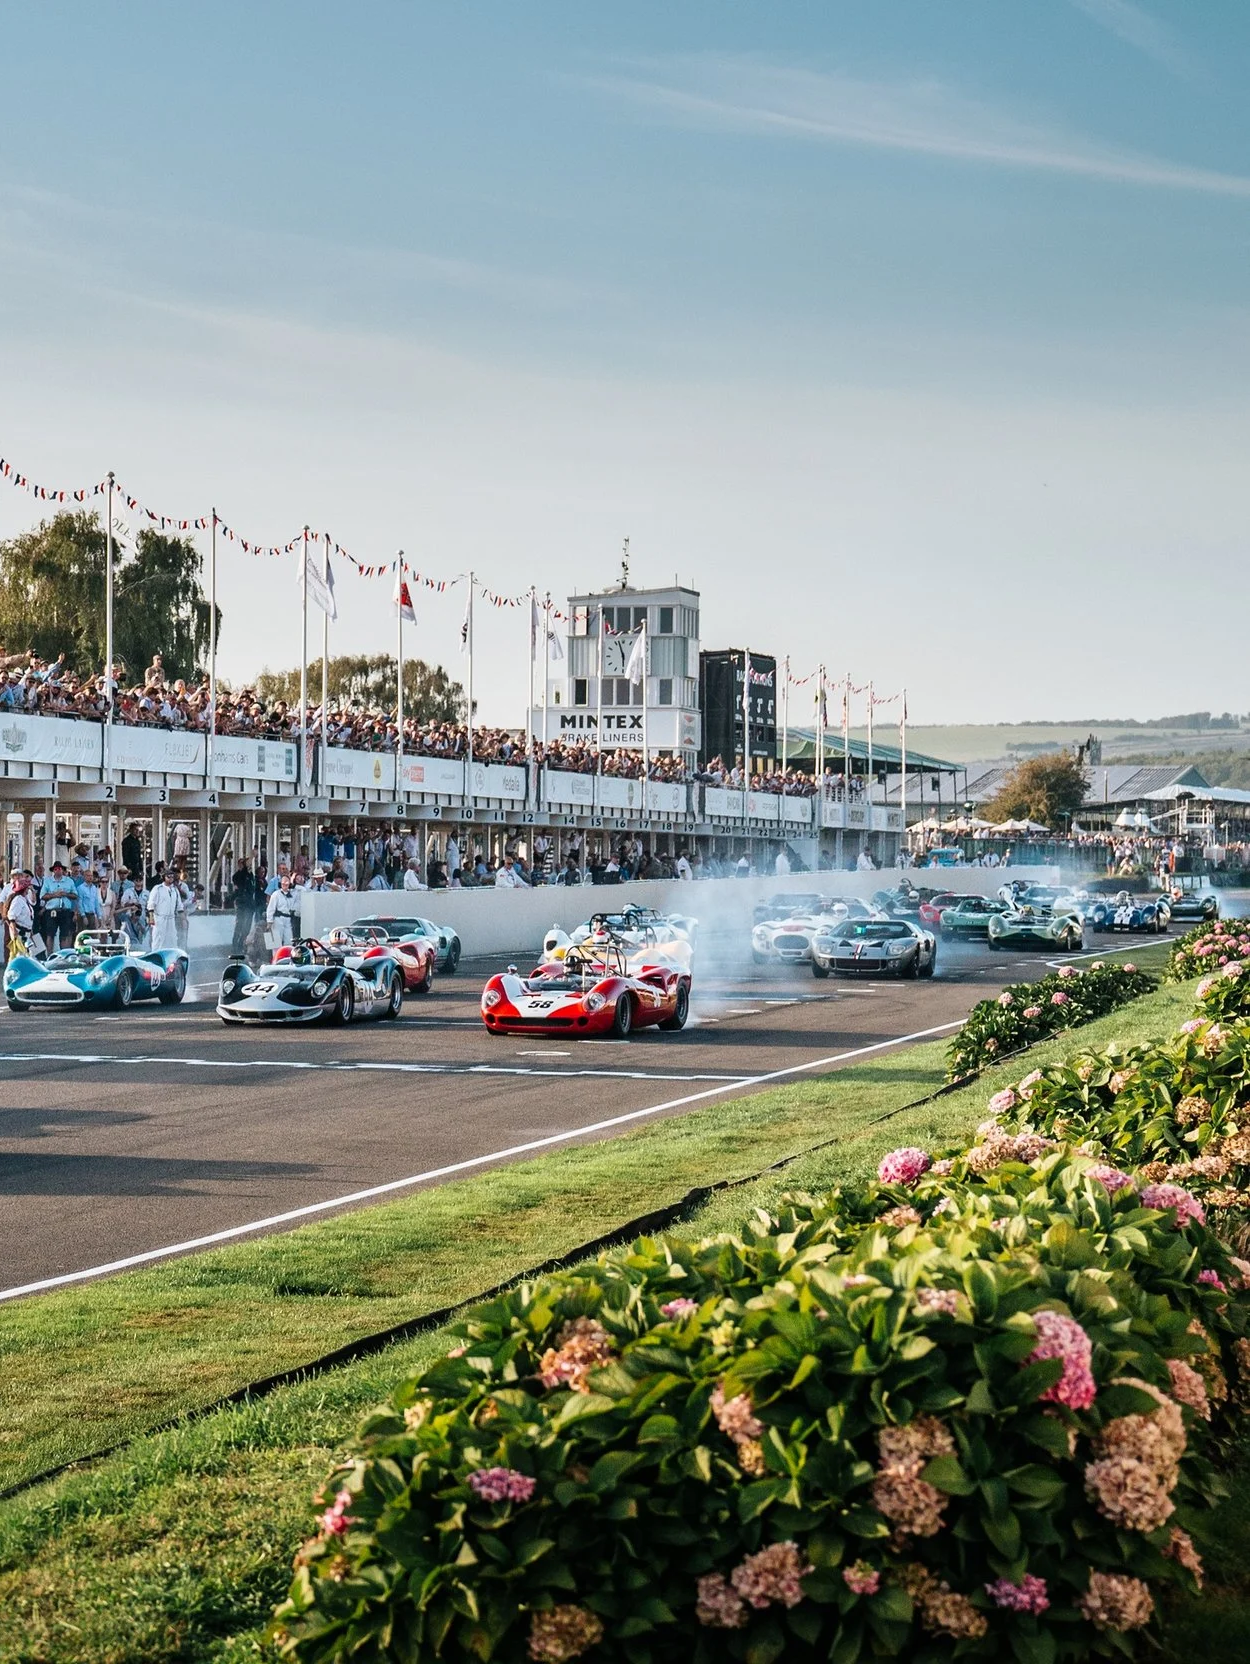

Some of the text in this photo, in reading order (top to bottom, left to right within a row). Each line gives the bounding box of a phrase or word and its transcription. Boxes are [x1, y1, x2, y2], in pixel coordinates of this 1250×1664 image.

[112, 517, 135, 541] OLE
[560, 715, 644, 729] MINTEX
[602, 733, 644, 743] LINERS
[214, 751, 237, 764] onhams
[51, 782, 55, 795] 1
[105, 786, 114, 799] 2
[159, 790, 166, 802] 3
[208, 793, 216, 804] 4
[255, 796, 262, 807] 5
[298, 798, 306, 809] 6
[359, 803, 366, 813] 7
[397, 805, 404, 815] 8
[433, 807, 440, 817] 9
[461, 810, 472, 819] 10
[494, 811, 504, 821] 11
[522, 813, 534, 823] 12
[564, 816, 575, 825] 14
[591, 818, 601, 827] 15
[615, 819, 626, 828] 16
[639, 821, 649, 829] 17
[662, 822, 672, 831] 18
[684, 824, 694, 832] 19
[721, 826, 731, 834] 20
[758, 829, 768, 837] 22
[244, 984, 275, 993] 44
[528, 1000, 554, 1009] 58
